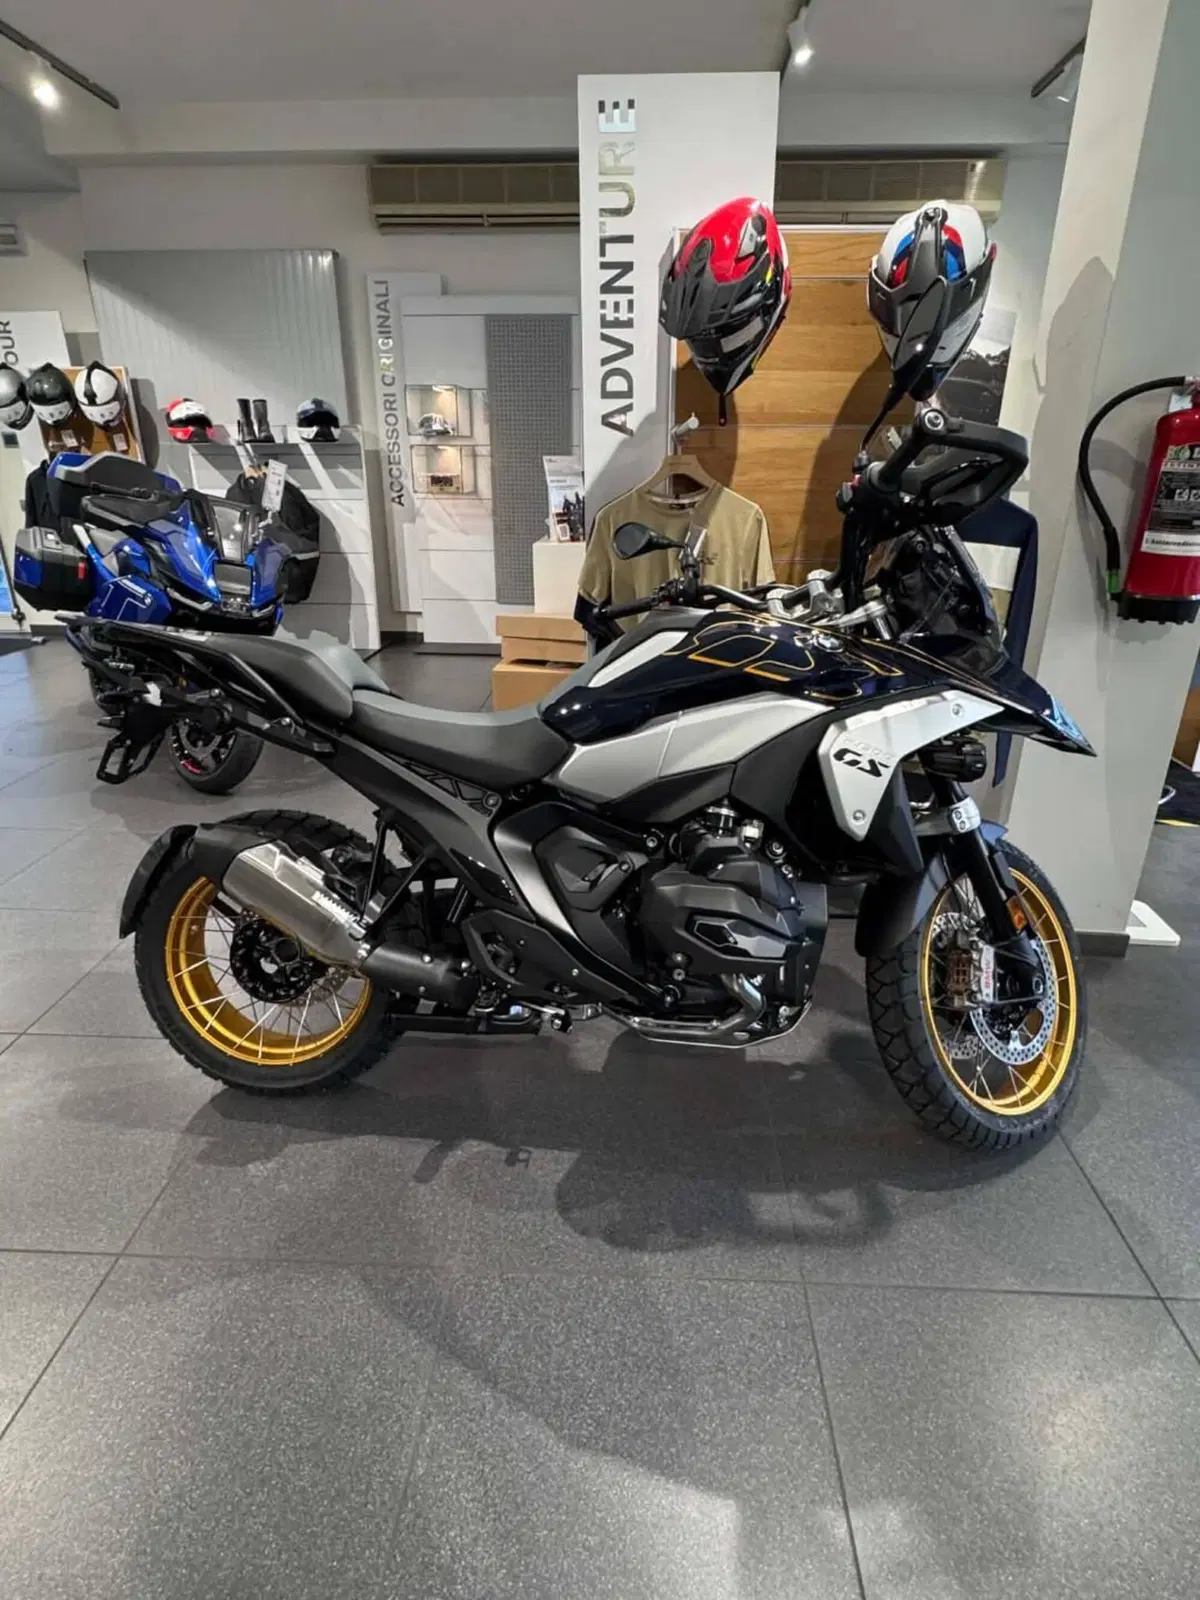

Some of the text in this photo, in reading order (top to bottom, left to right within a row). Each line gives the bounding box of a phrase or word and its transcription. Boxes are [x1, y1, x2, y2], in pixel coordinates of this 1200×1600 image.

[598, 98, 637, 437] ADVENTURE
[382, 392, 405, 507] ACCESSORI
[833, 747, 890, 778] GS
